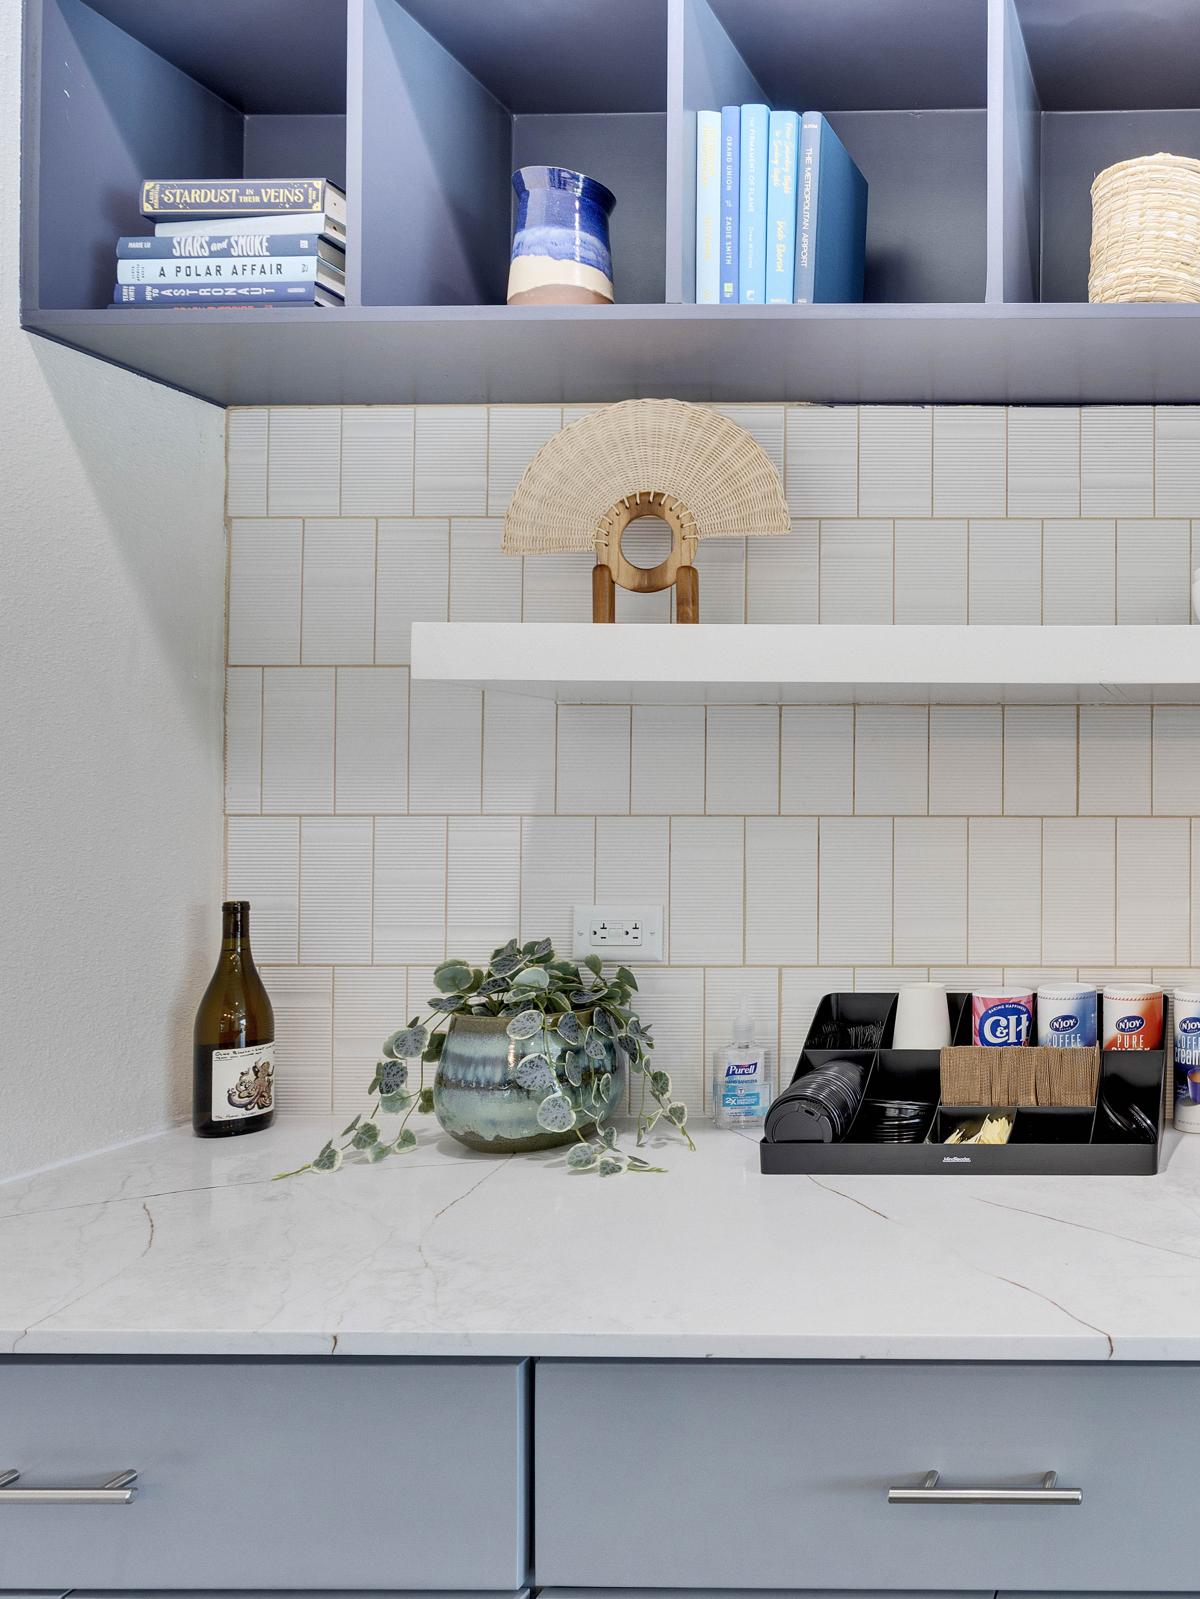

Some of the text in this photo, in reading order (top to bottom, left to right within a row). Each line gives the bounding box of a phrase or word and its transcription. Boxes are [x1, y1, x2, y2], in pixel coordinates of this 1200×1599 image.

[163, 189, 240, 203] STARDUST
[261, 188, 304, 203] VEINS
[802, 167, 812, 229] METROPOLITAN
[172, 235, 271, 257] STARS and SMOKE
[800, 232, 809, 268] AIRPORT
[158, 266, 167, 278] A
[175, 265, 222, 277] POLAR
[231, 263, 283, 276] AFFAIR
[161, 287, 276, 296] ASTRONAUT
[983, 1013, 1030, 1044] C&H
[1117, 1034, 1144, 1048] PURE
[729, 1064, 755, 1075] Purell
